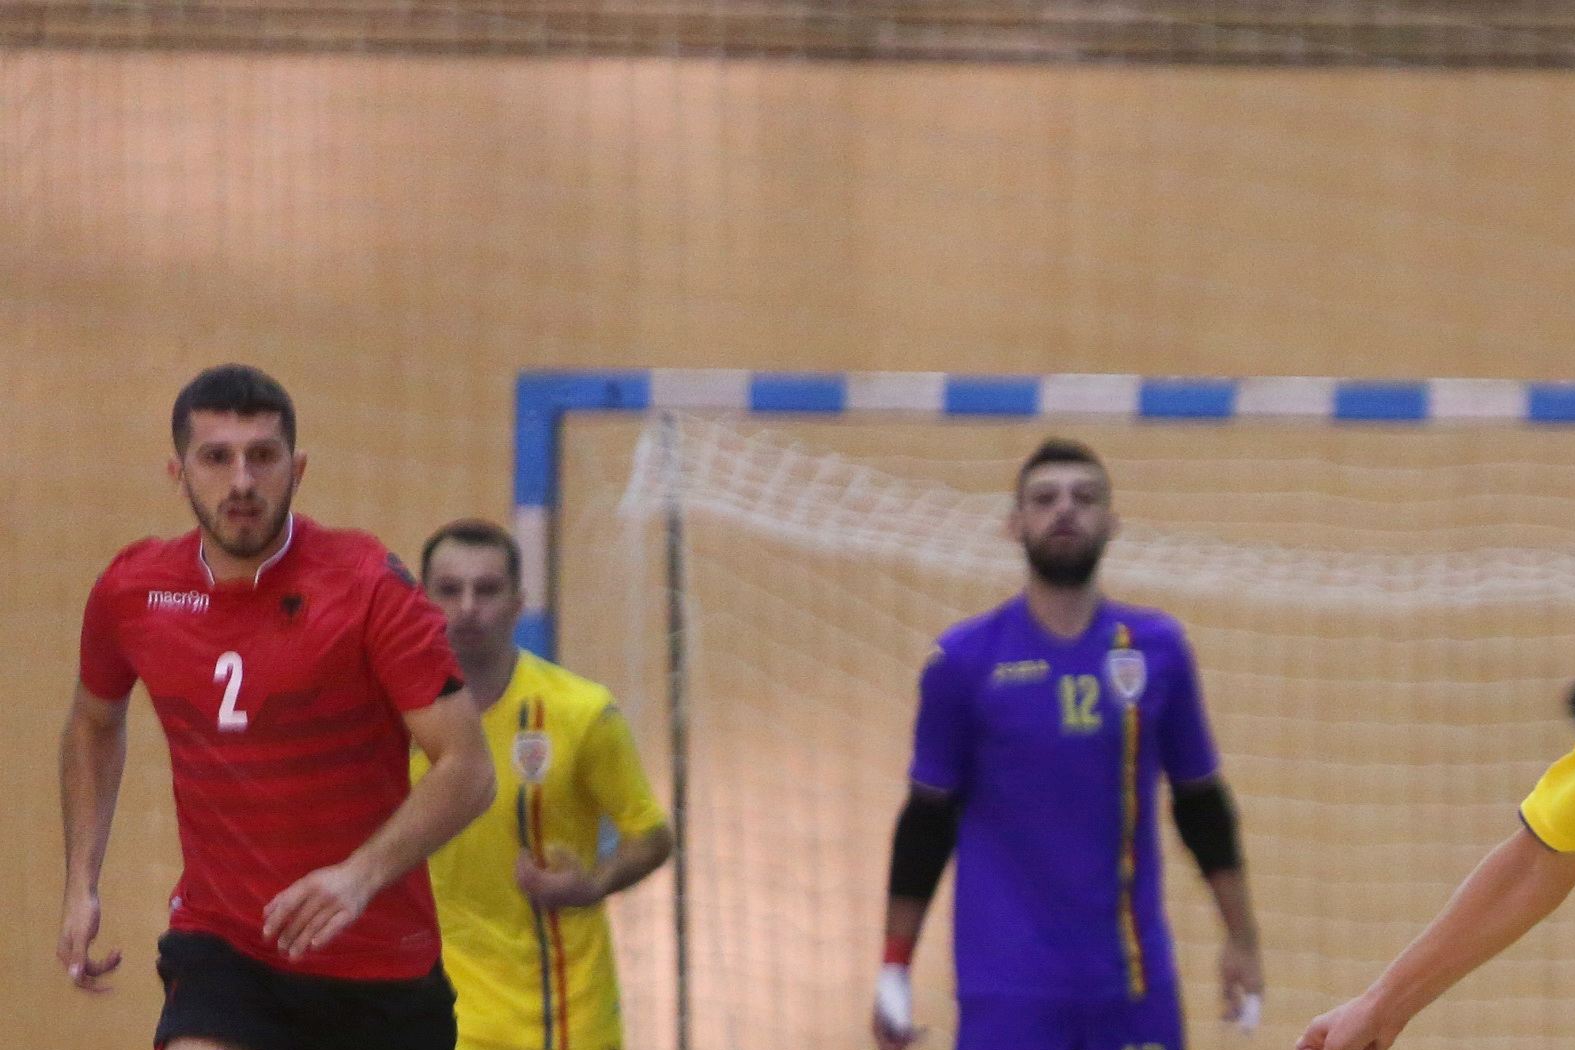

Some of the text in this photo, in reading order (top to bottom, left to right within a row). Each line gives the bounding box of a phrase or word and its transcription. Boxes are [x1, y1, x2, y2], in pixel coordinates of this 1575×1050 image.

[148, 591, 210, 612] macron
[213, 651, 248, 729] 2
[1061, 675, 1102, 729] 12
